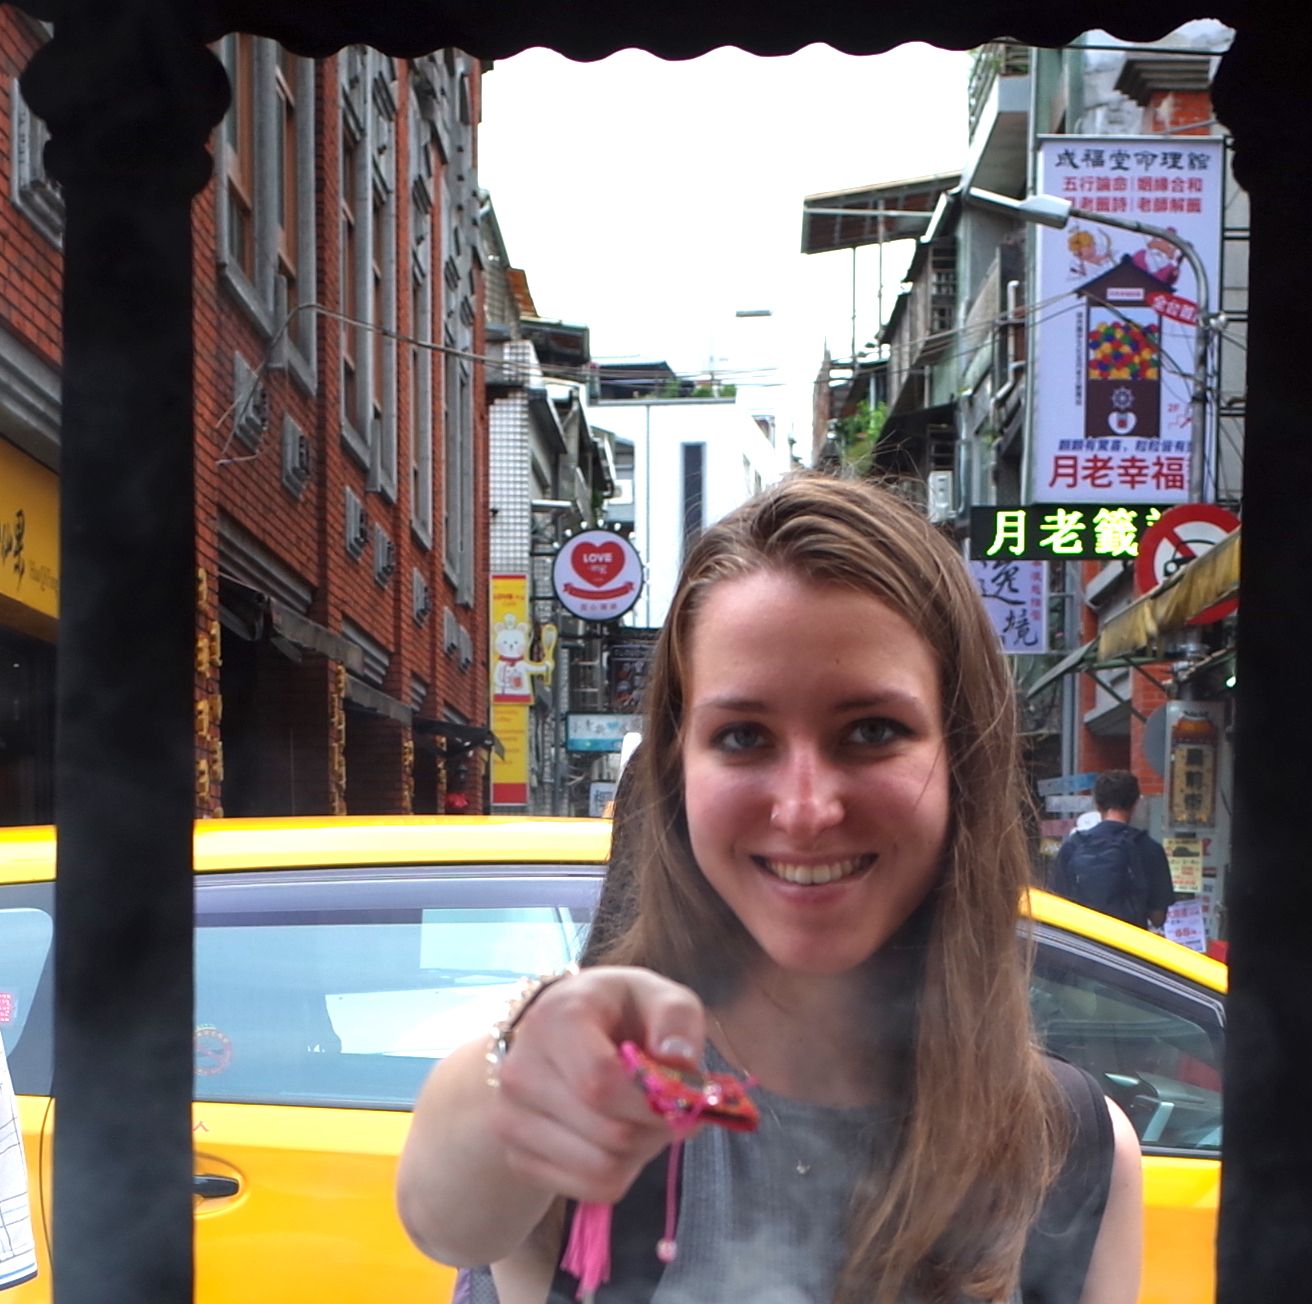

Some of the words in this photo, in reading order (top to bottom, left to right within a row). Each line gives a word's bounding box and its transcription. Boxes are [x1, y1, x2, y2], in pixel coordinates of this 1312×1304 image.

[1049, 453, 1191, 490] 月老幸福
[986, 507, 1162, 557] 月老籤
[583, 552, 613, 563] LOVE
